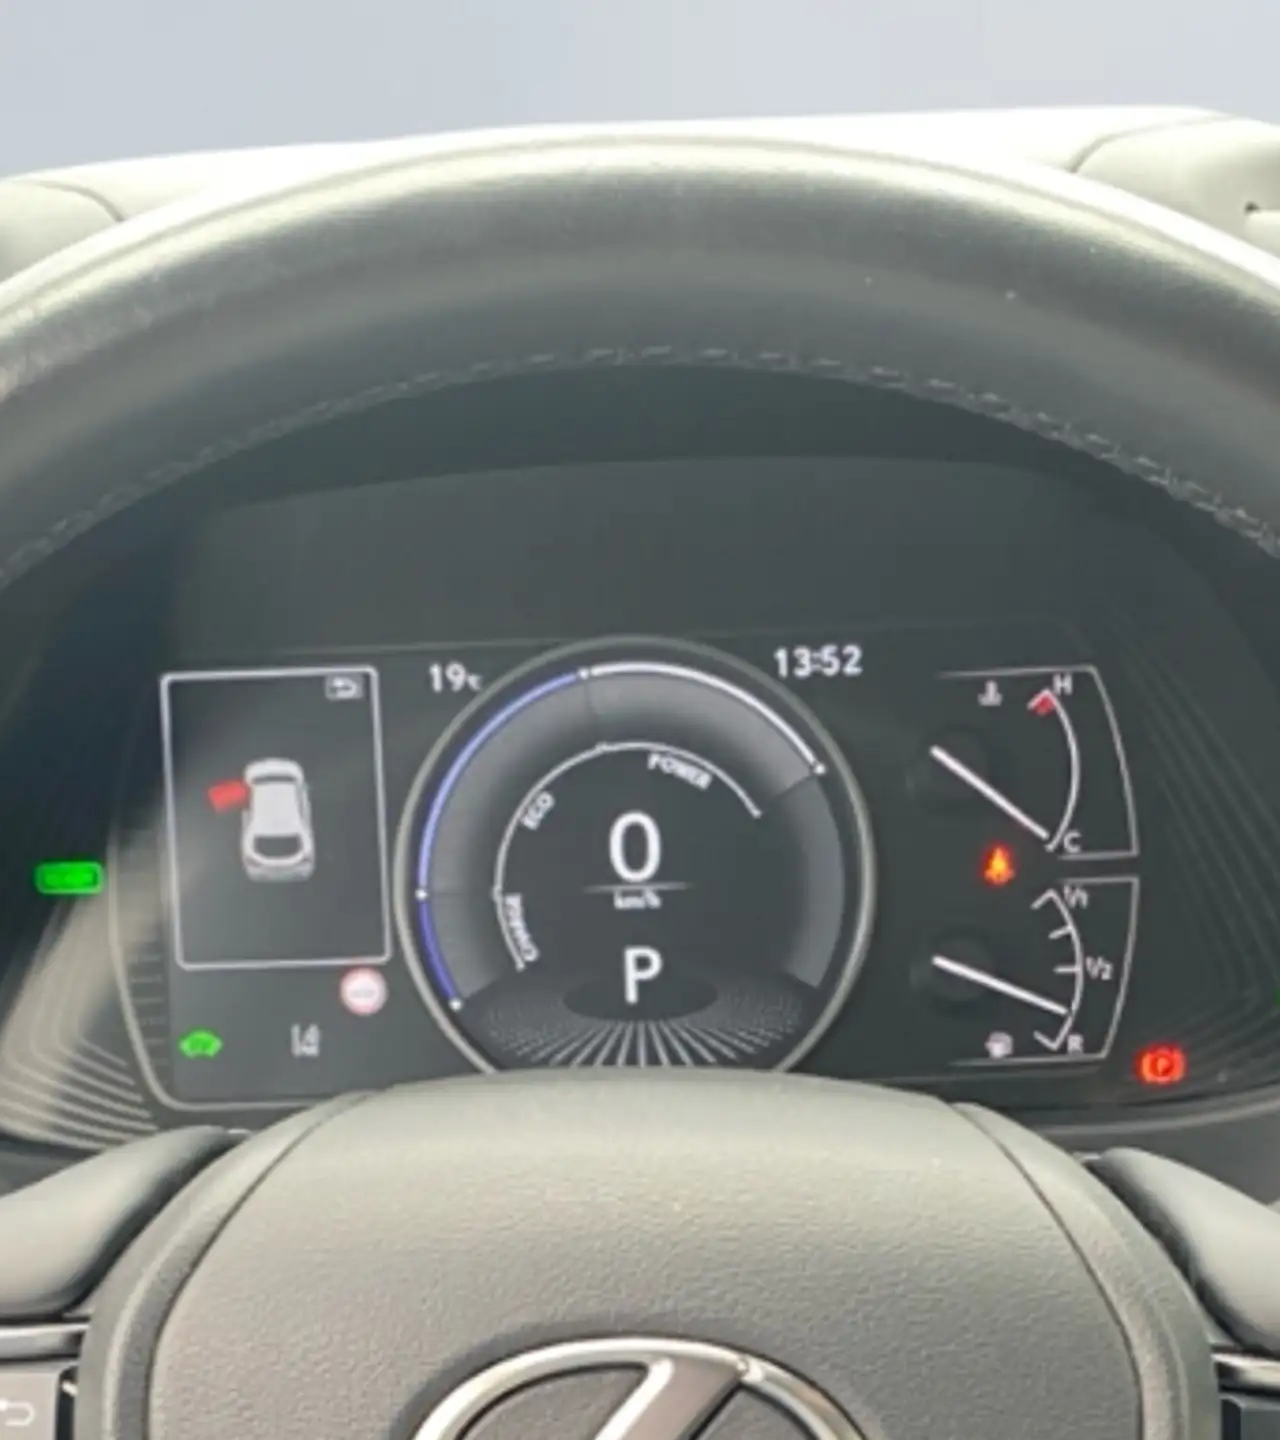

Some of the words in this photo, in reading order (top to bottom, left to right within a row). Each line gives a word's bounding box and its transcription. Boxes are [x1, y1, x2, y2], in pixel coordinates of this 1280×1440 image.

[774, 647, 862, 677] 13:52
[1054, 675, 1073, 694] H
[647, 753, 712, 790] POWER
[609, 812, 661, 882] 0
[1063, 833, 1081, 853] C
[623, 946, 662, 1004] P
